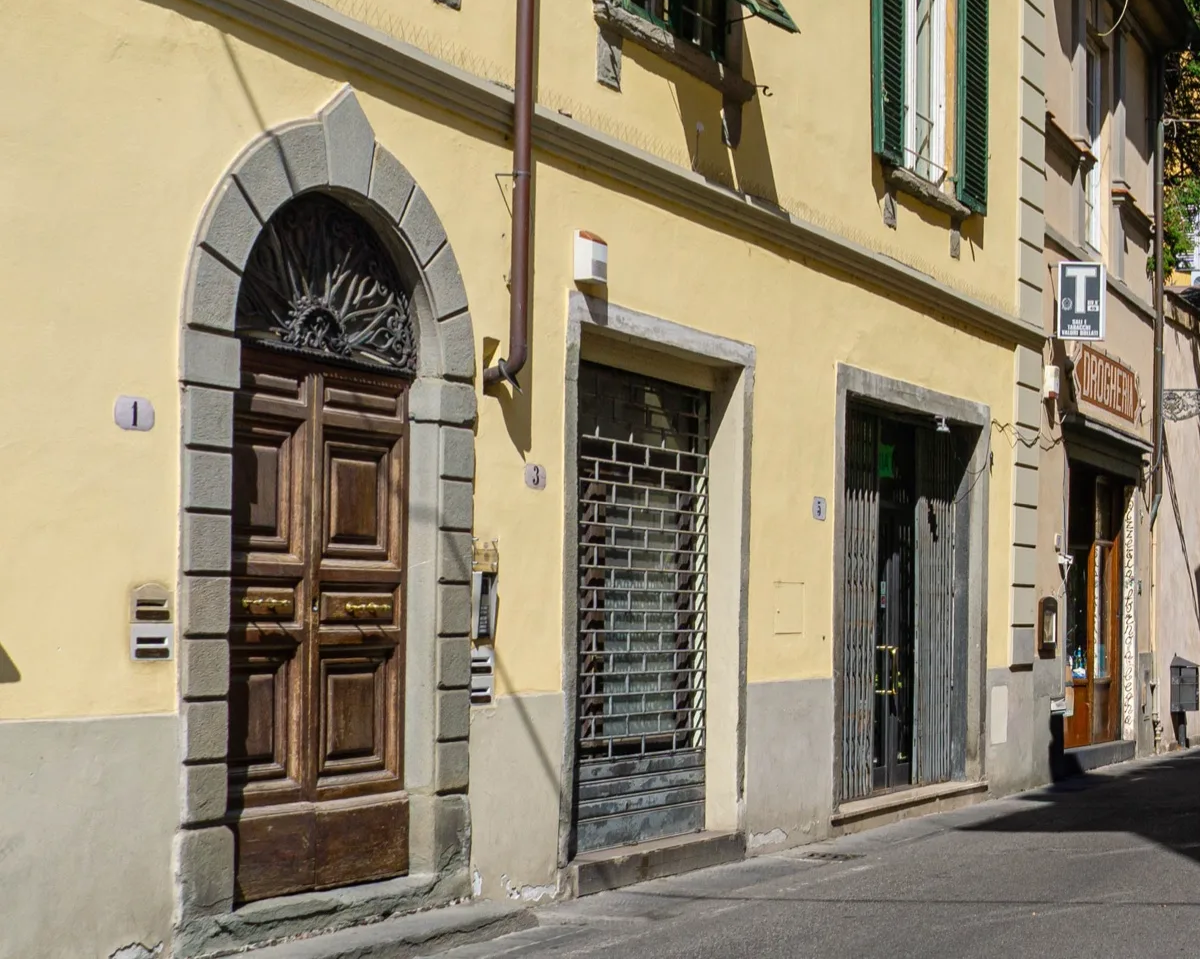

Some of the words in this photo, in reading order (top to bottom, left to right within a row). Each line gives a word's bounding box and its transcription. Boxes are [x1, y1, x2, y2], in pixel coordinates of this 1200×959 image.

[1065, 266, 1098, 314] T
[1082, 350, 1134, 419] DROGHERIA
[131, 400, 138, 427] 1
[532, 465, 540, 486] 3
